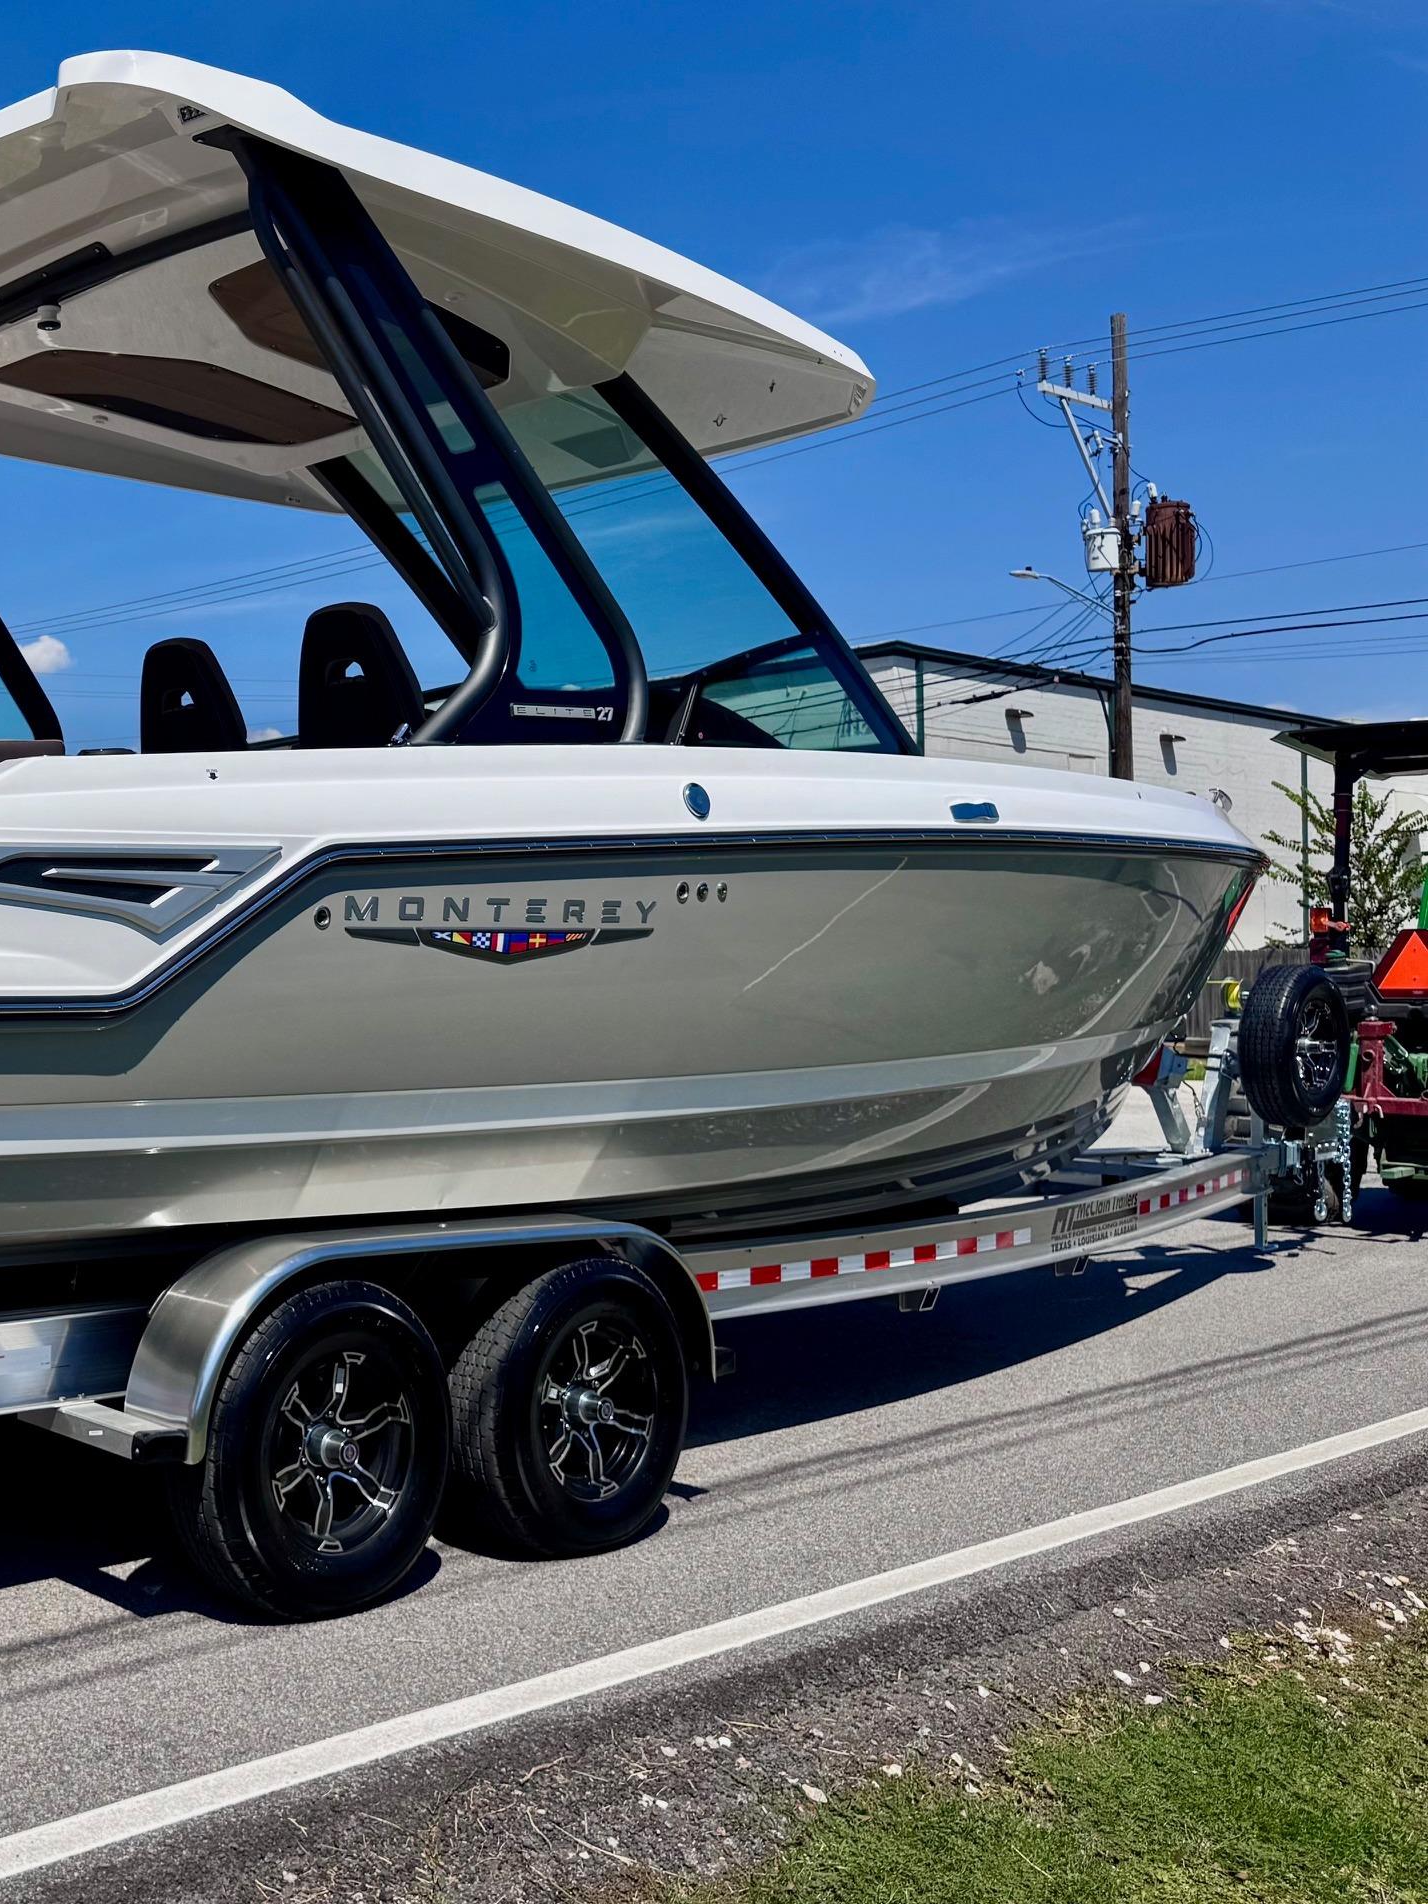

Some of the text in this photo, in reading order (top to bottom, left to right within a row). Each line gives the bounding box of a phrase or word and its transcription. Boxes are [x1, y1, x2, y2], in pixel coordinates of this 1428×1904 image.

[516, 706, 614, 721] ELITE 27
[343, 895, 657, 924] MONTEREY
[1051, 1224, 1138, 1253] TEXAS LOUISIANA ALABAMA
